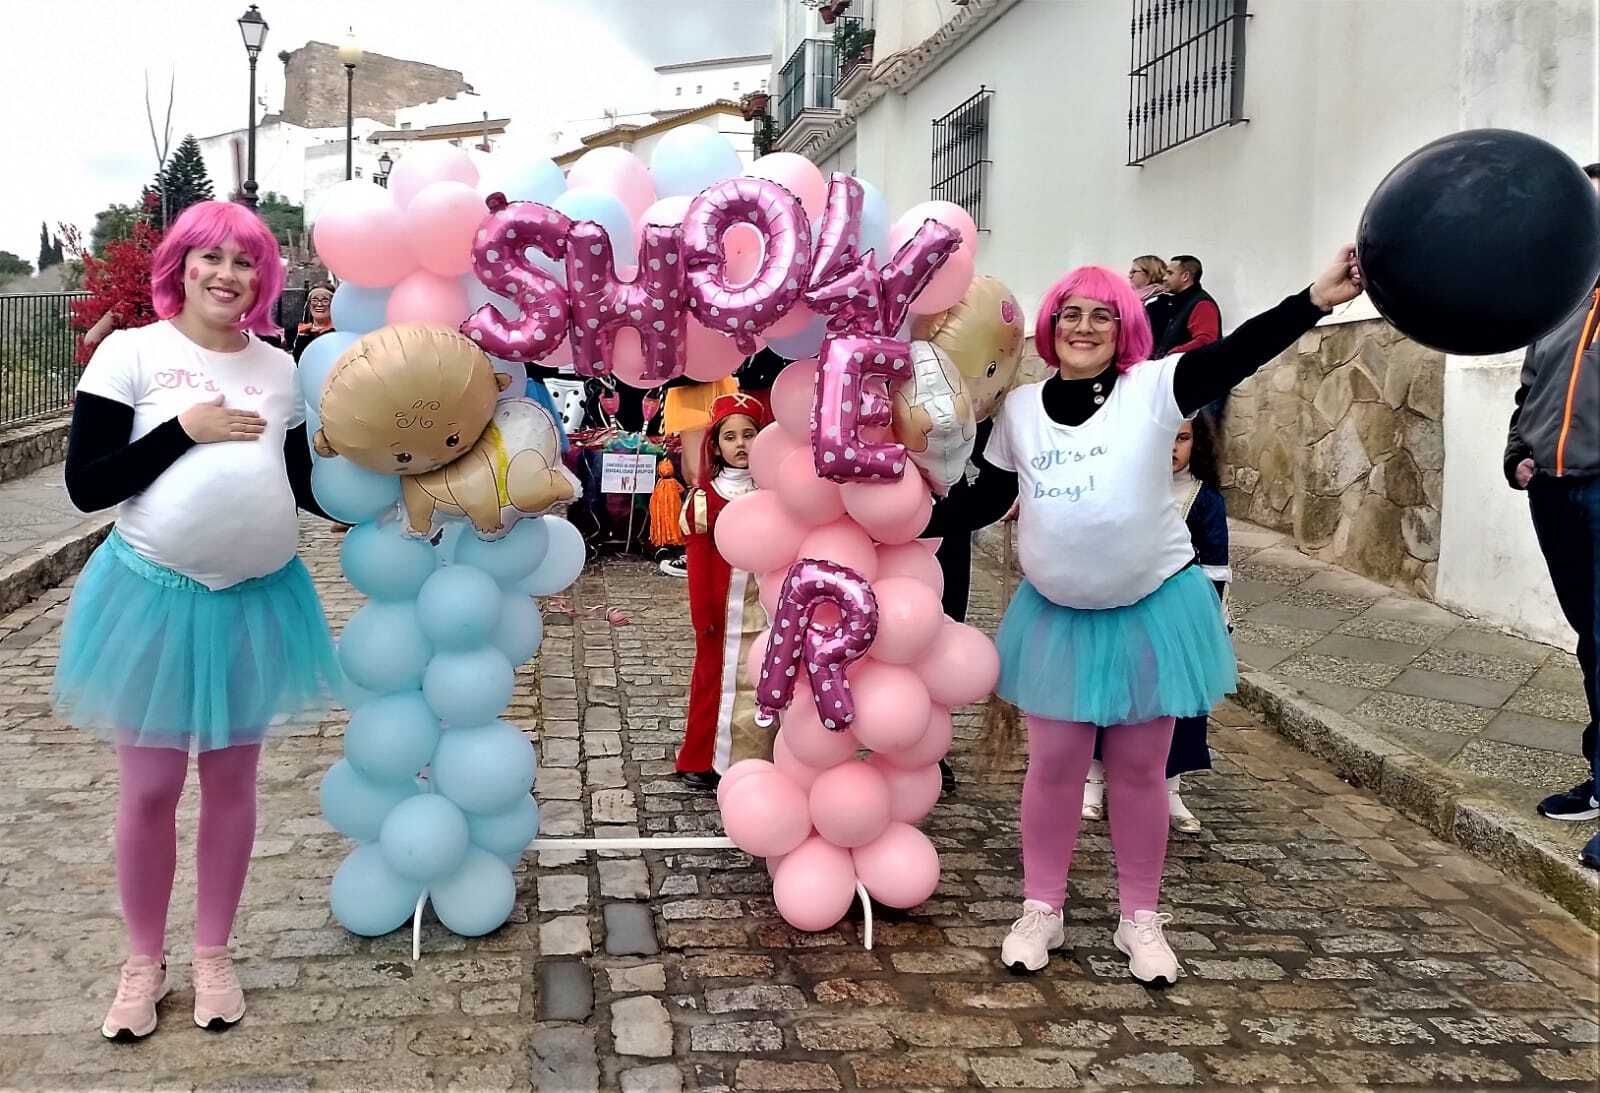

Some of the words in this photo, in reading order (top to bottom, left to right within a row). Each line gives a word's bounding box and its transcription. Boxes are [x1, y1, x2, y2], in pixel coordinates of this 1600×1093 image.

[244, 385, 263, 395] a
[1031, 449, 1087, 471] It's
[1089, 445, 1109, 457] a
[1032, 475, 1095, 503] boy!
